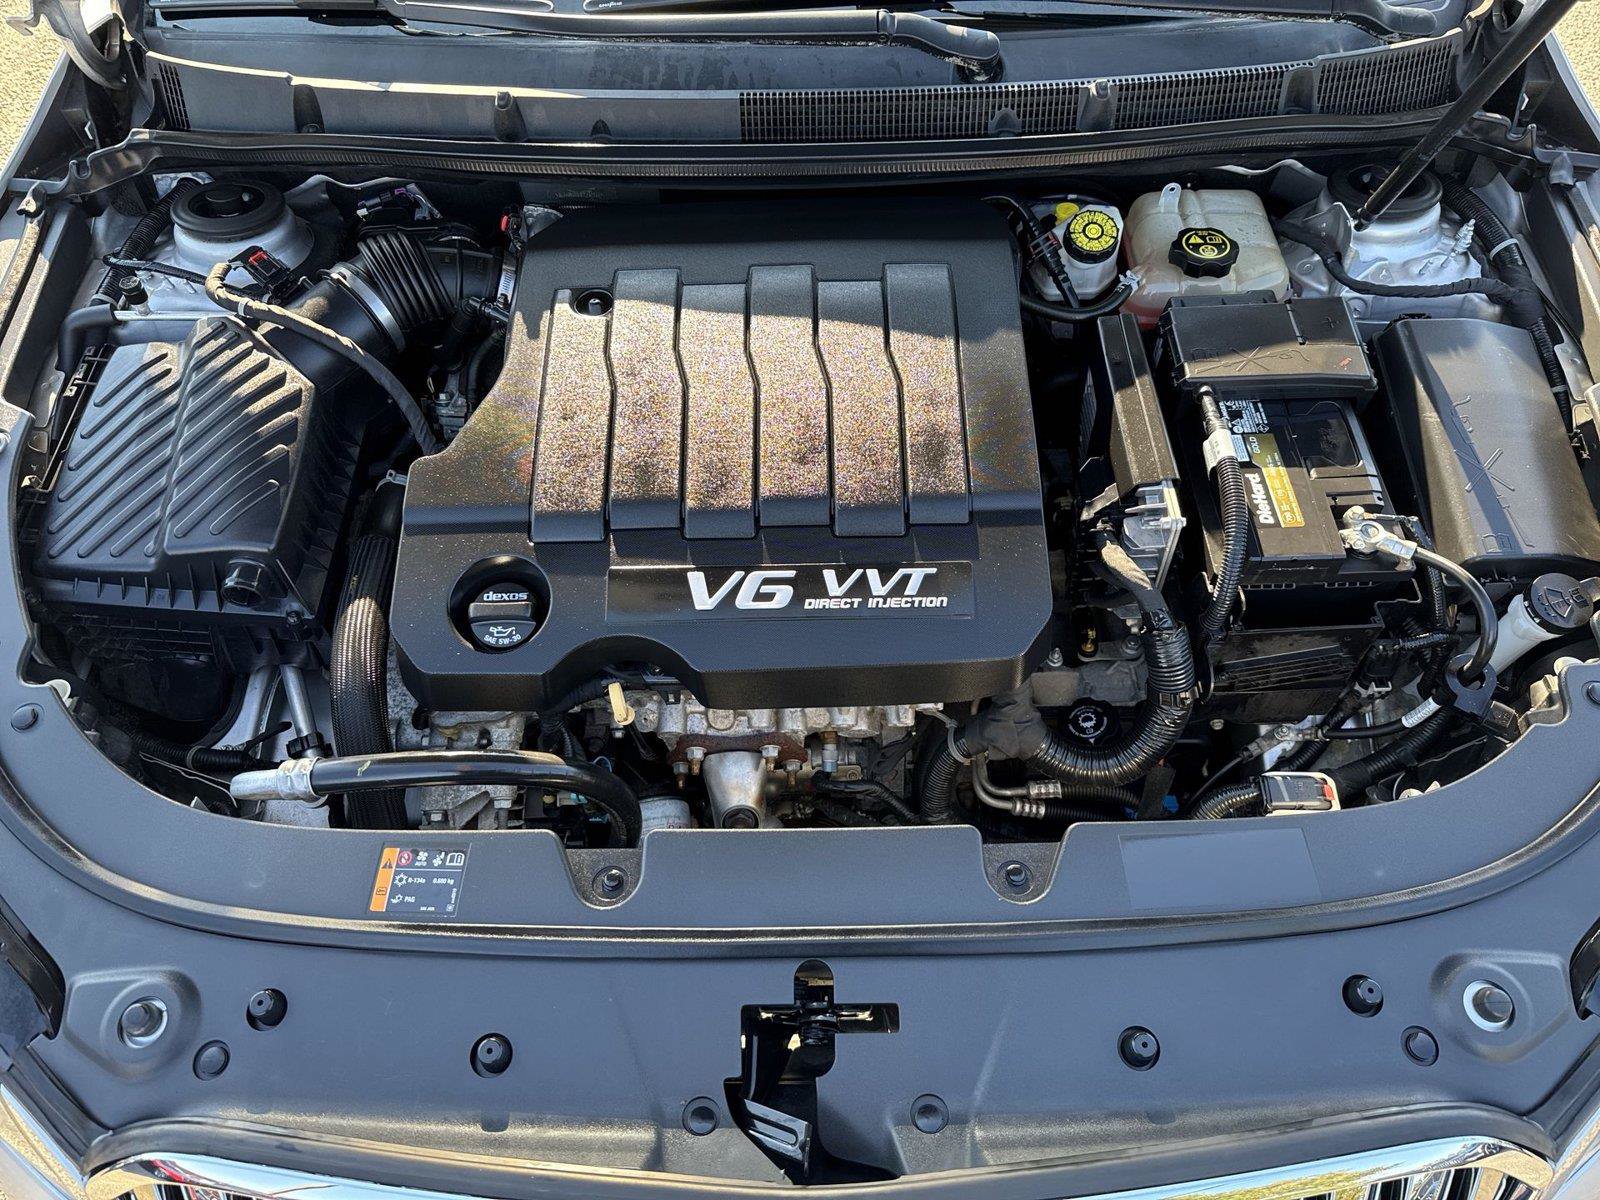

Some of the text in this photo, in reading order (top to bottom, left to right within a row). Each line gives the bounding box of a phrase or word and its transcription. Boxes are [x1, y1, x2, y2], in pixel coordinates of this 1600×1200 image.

[1249, 436, 1261, 454] GOLD
[1244, 472, 1275, 524] DieHard
[483, 591, 529, 601] dexos
[686, 567, 938, 611] V6 VVT
[803, 596, 948, 610] DIRECT INJECTION
[483, 633, 522, 645] SAE 5W-30
